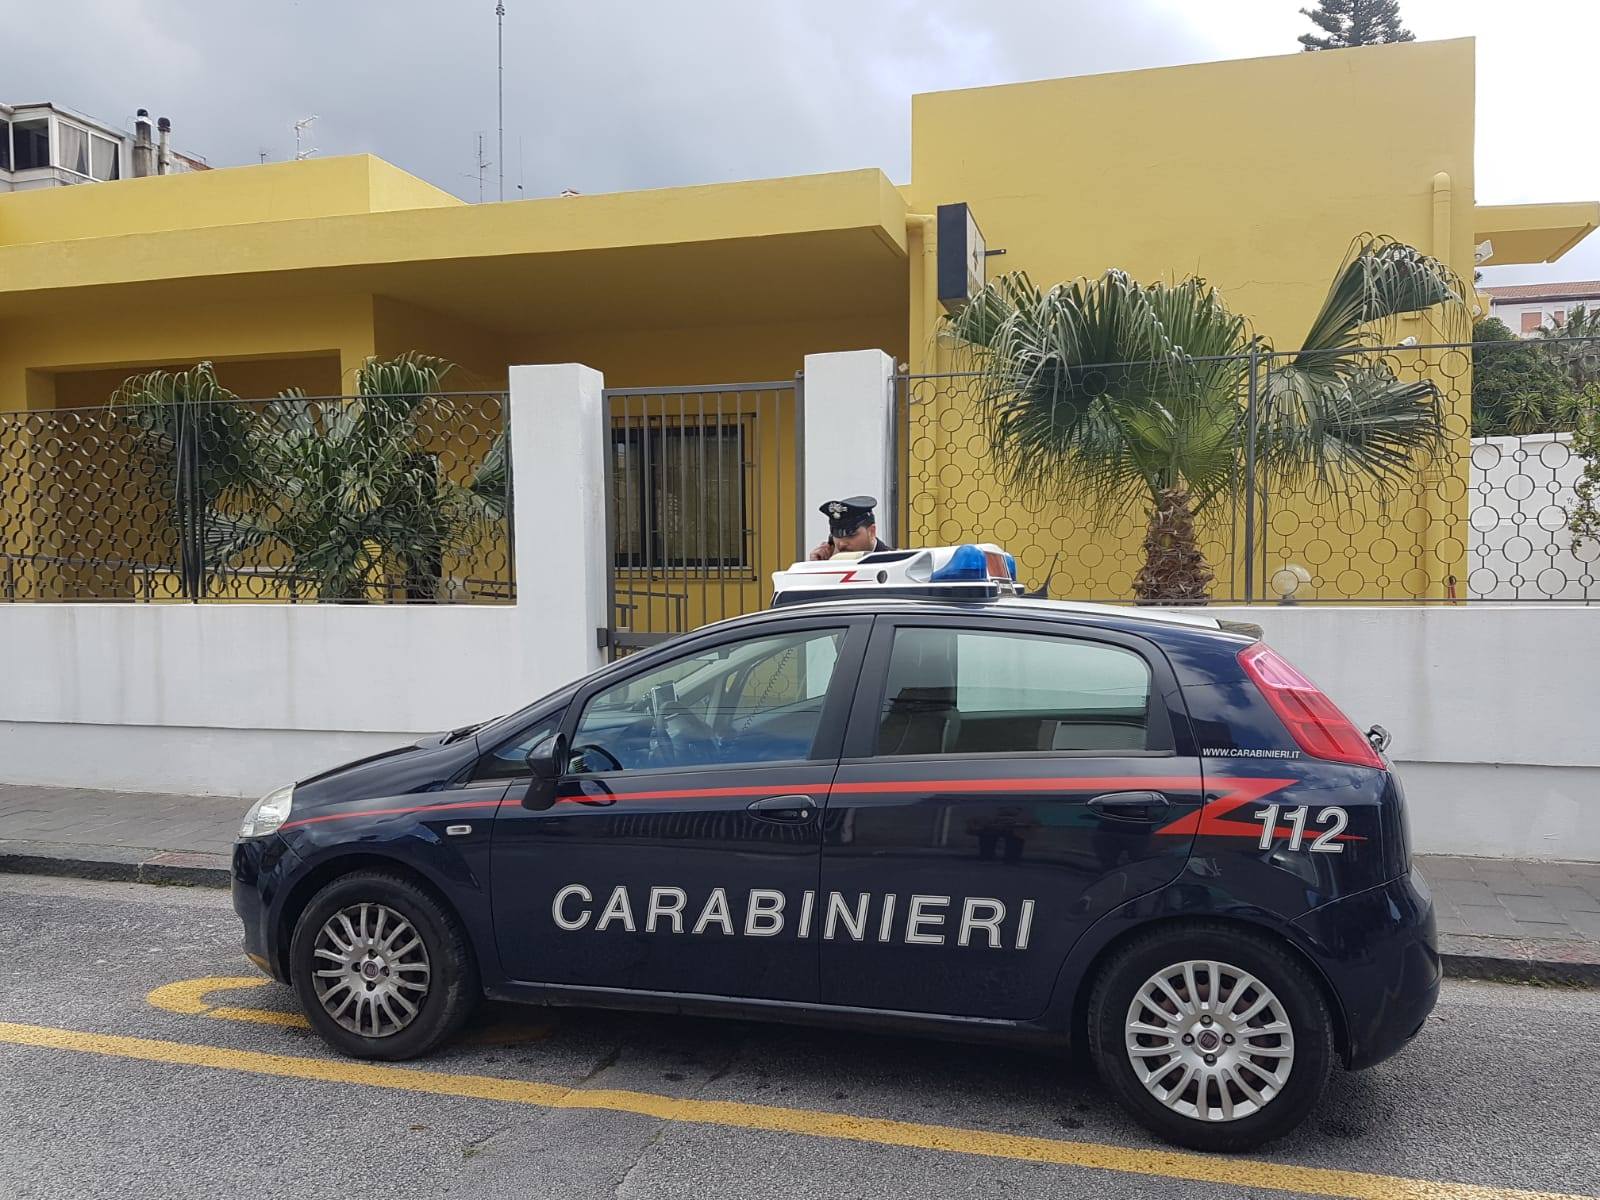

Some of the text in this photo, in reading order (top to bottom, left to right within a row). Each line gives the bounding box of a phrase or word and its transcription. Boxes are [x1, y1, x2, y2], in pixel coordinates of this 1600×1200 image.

[1202, 747, 1300, 759] WWW.CARABINIERI.IT
[1254, 803, 1349, 853] 112
[552, 884, 1035, 950] CARABINIERI
